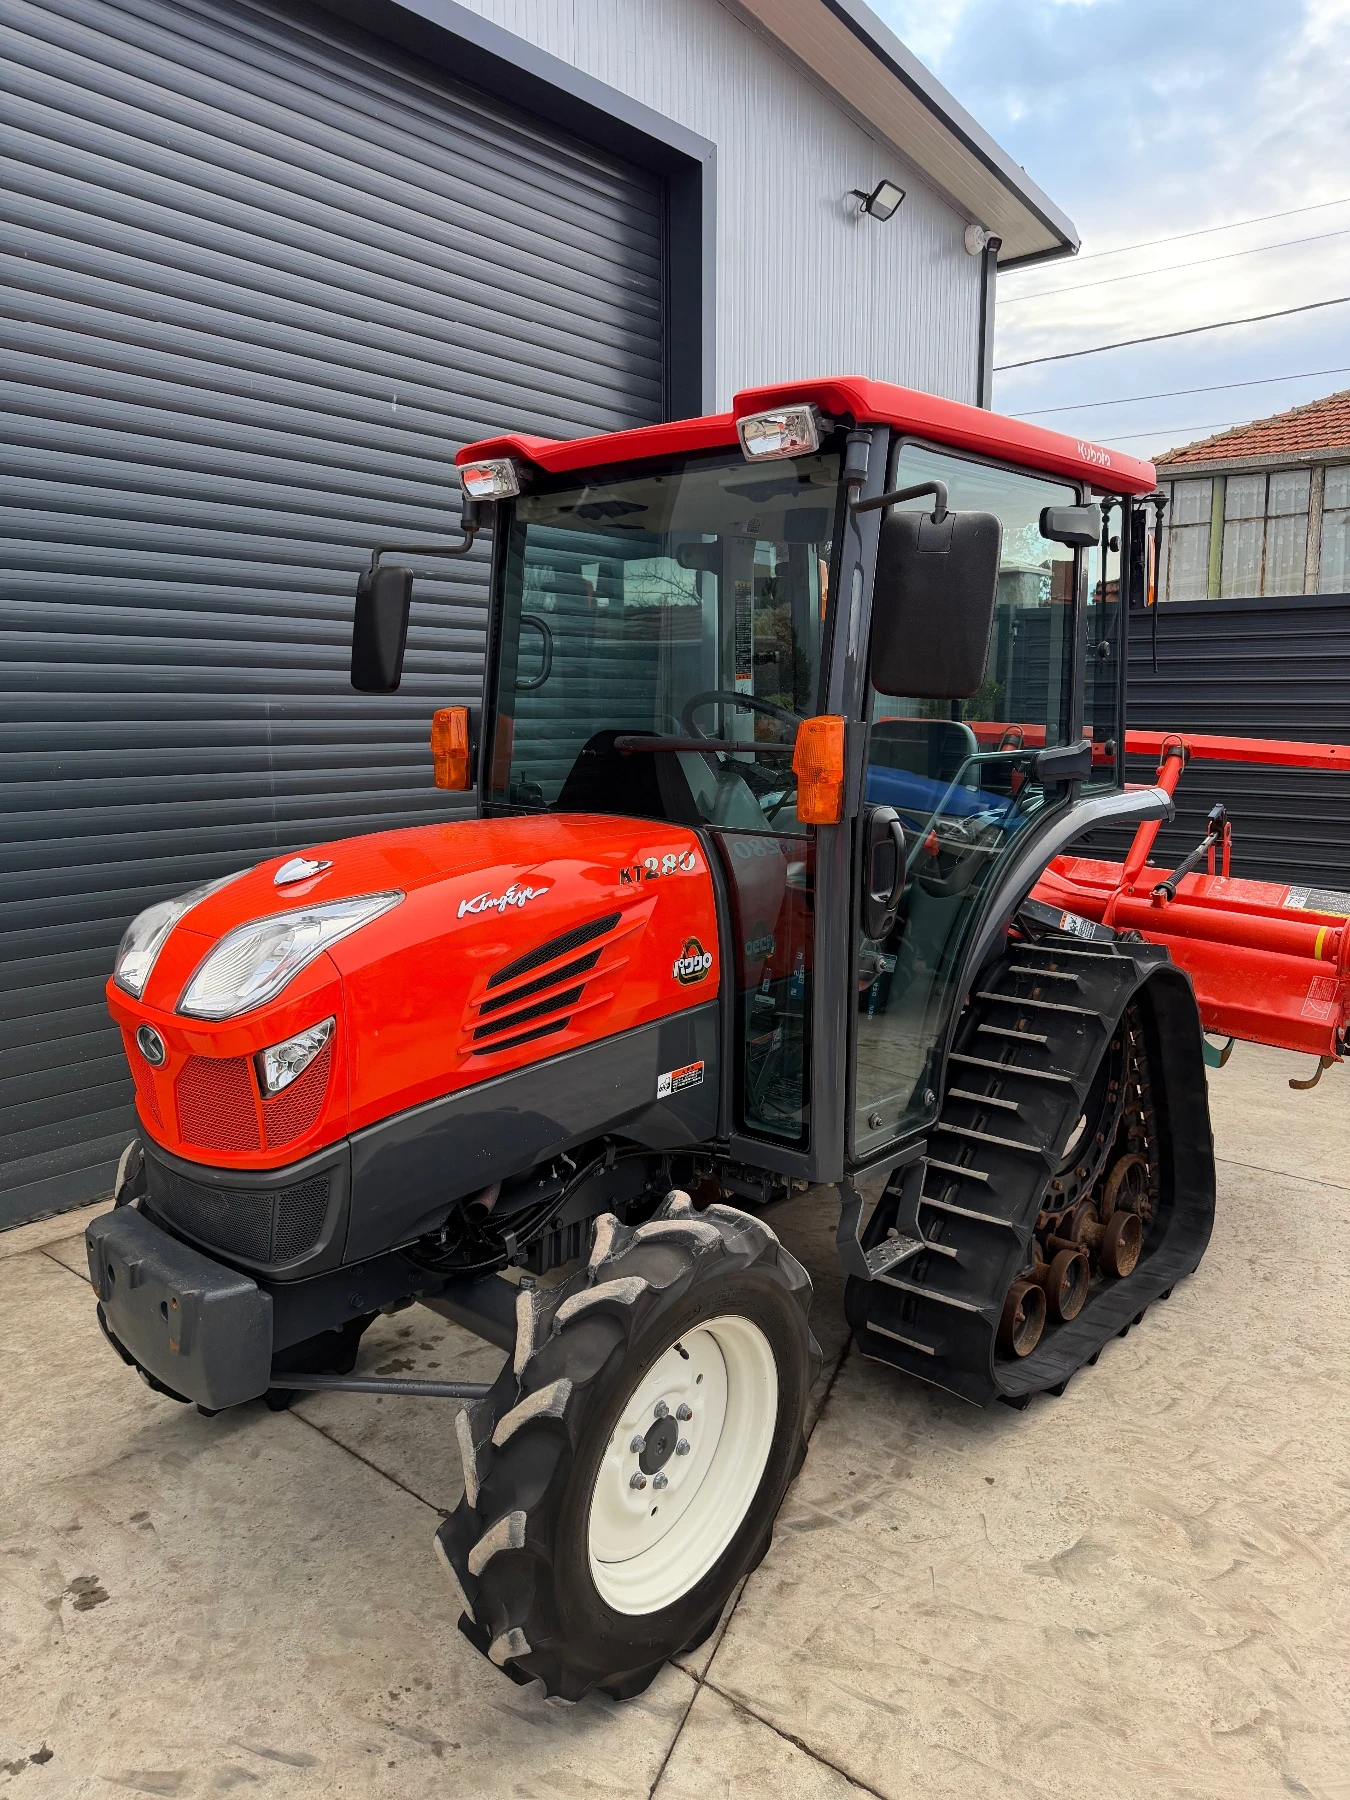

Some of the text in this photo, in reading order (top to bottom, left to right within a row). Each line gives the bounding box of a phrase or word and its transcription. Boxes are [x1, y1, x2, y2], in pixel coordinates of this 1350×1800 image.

[1076, 440, 1111, 467] Kubota
[618, 850, 697, 886] KT280
[456, 881, 550, 919] KingEye
